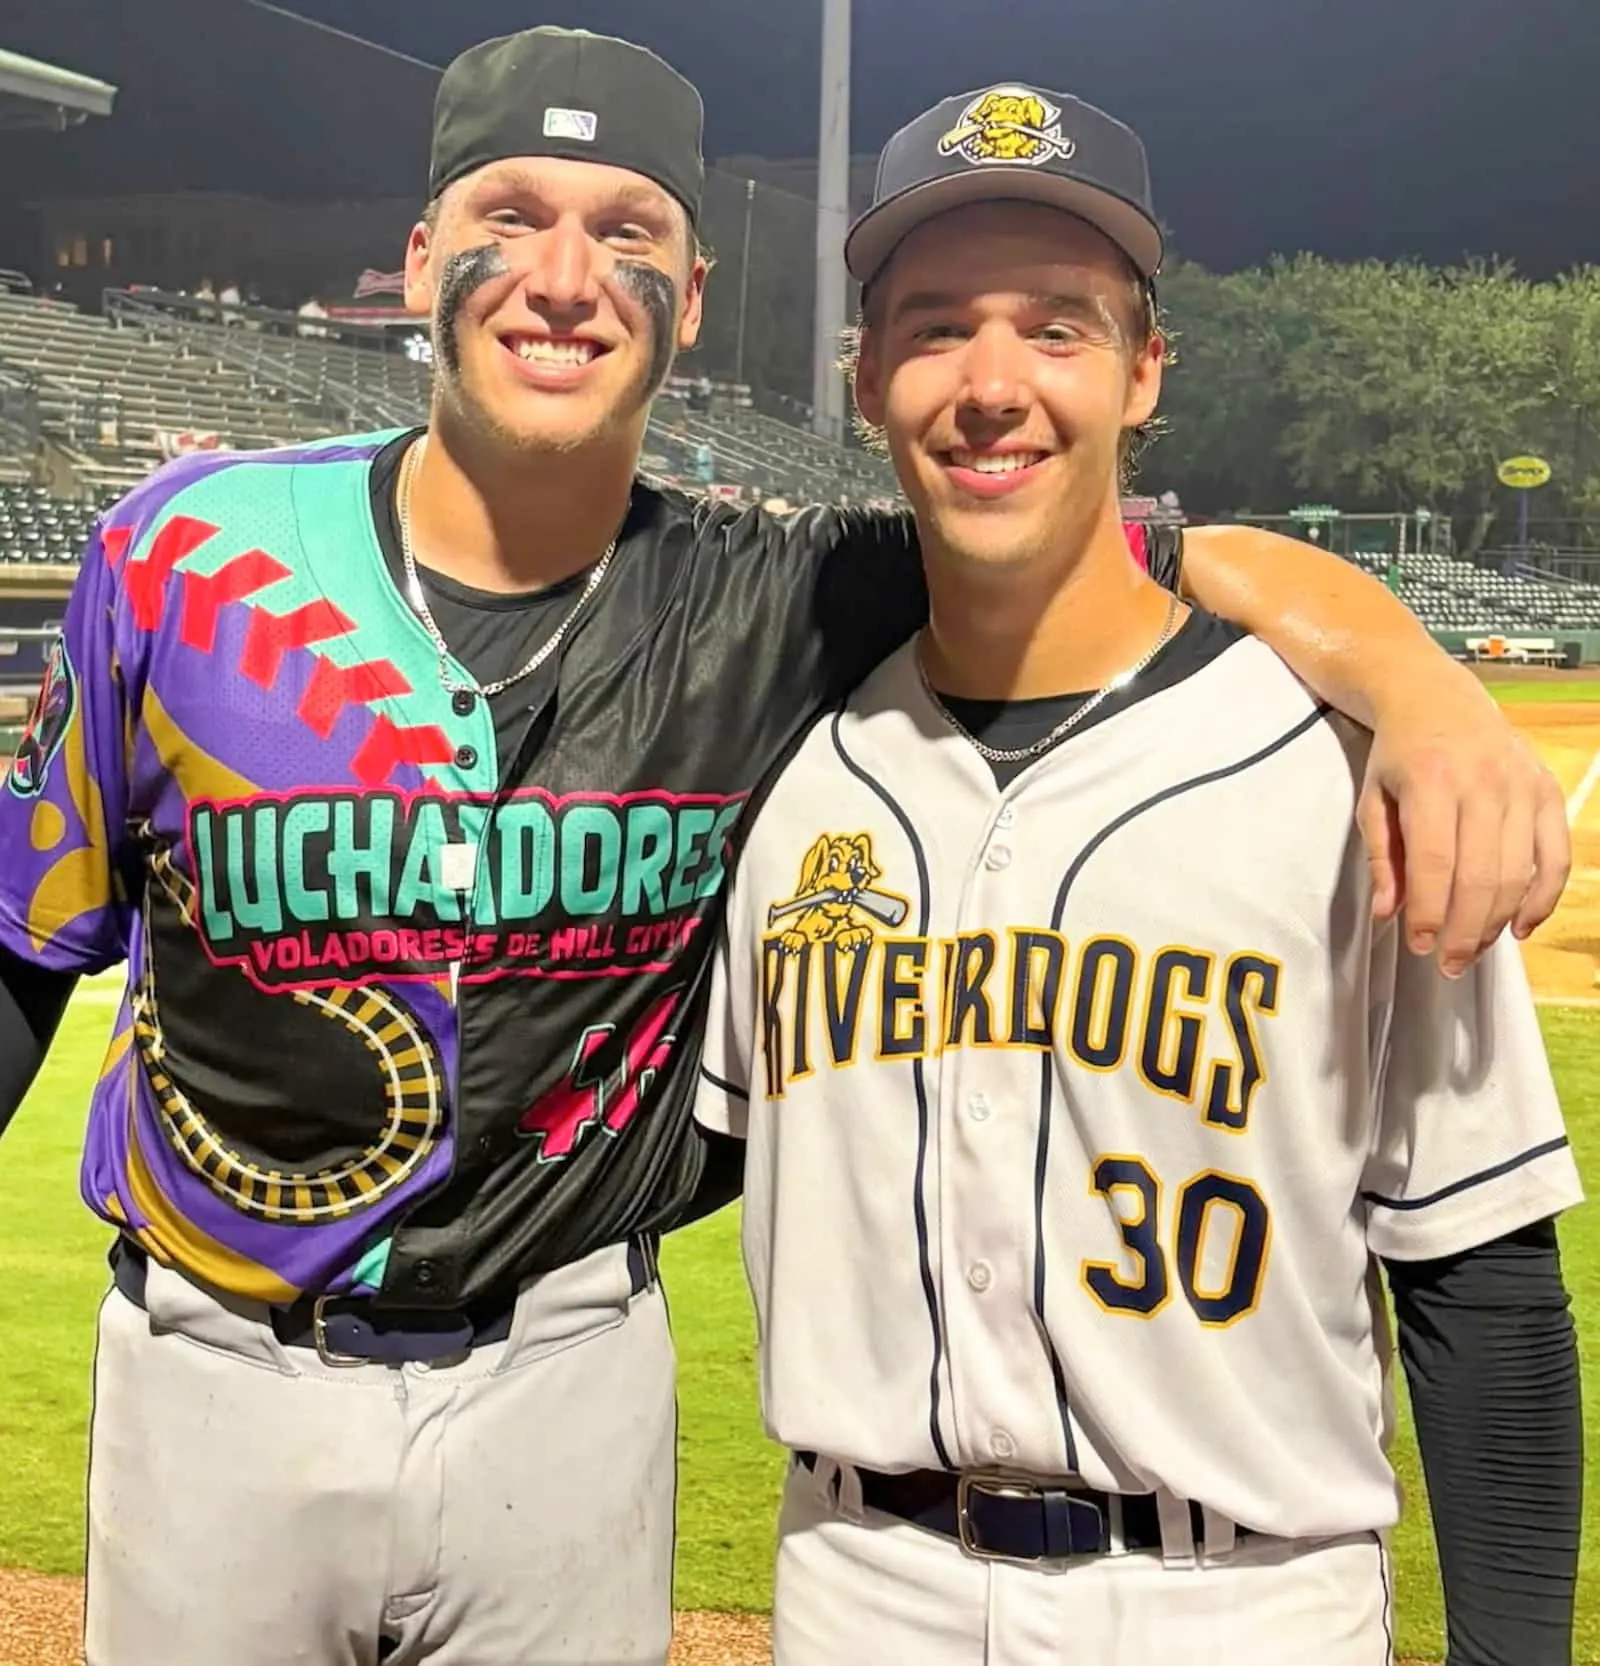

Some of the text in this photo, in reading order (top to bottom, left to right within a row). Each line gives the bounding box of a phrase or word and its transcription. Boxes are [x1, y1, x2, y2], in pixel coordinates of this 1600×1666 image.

[507, 932, 541, 956] DE
[550, 924, 615, 960] HILL
[762, 927, 1284, 1135] RIVERDOGS
[1080, 1153, 1273, 1329] 30
